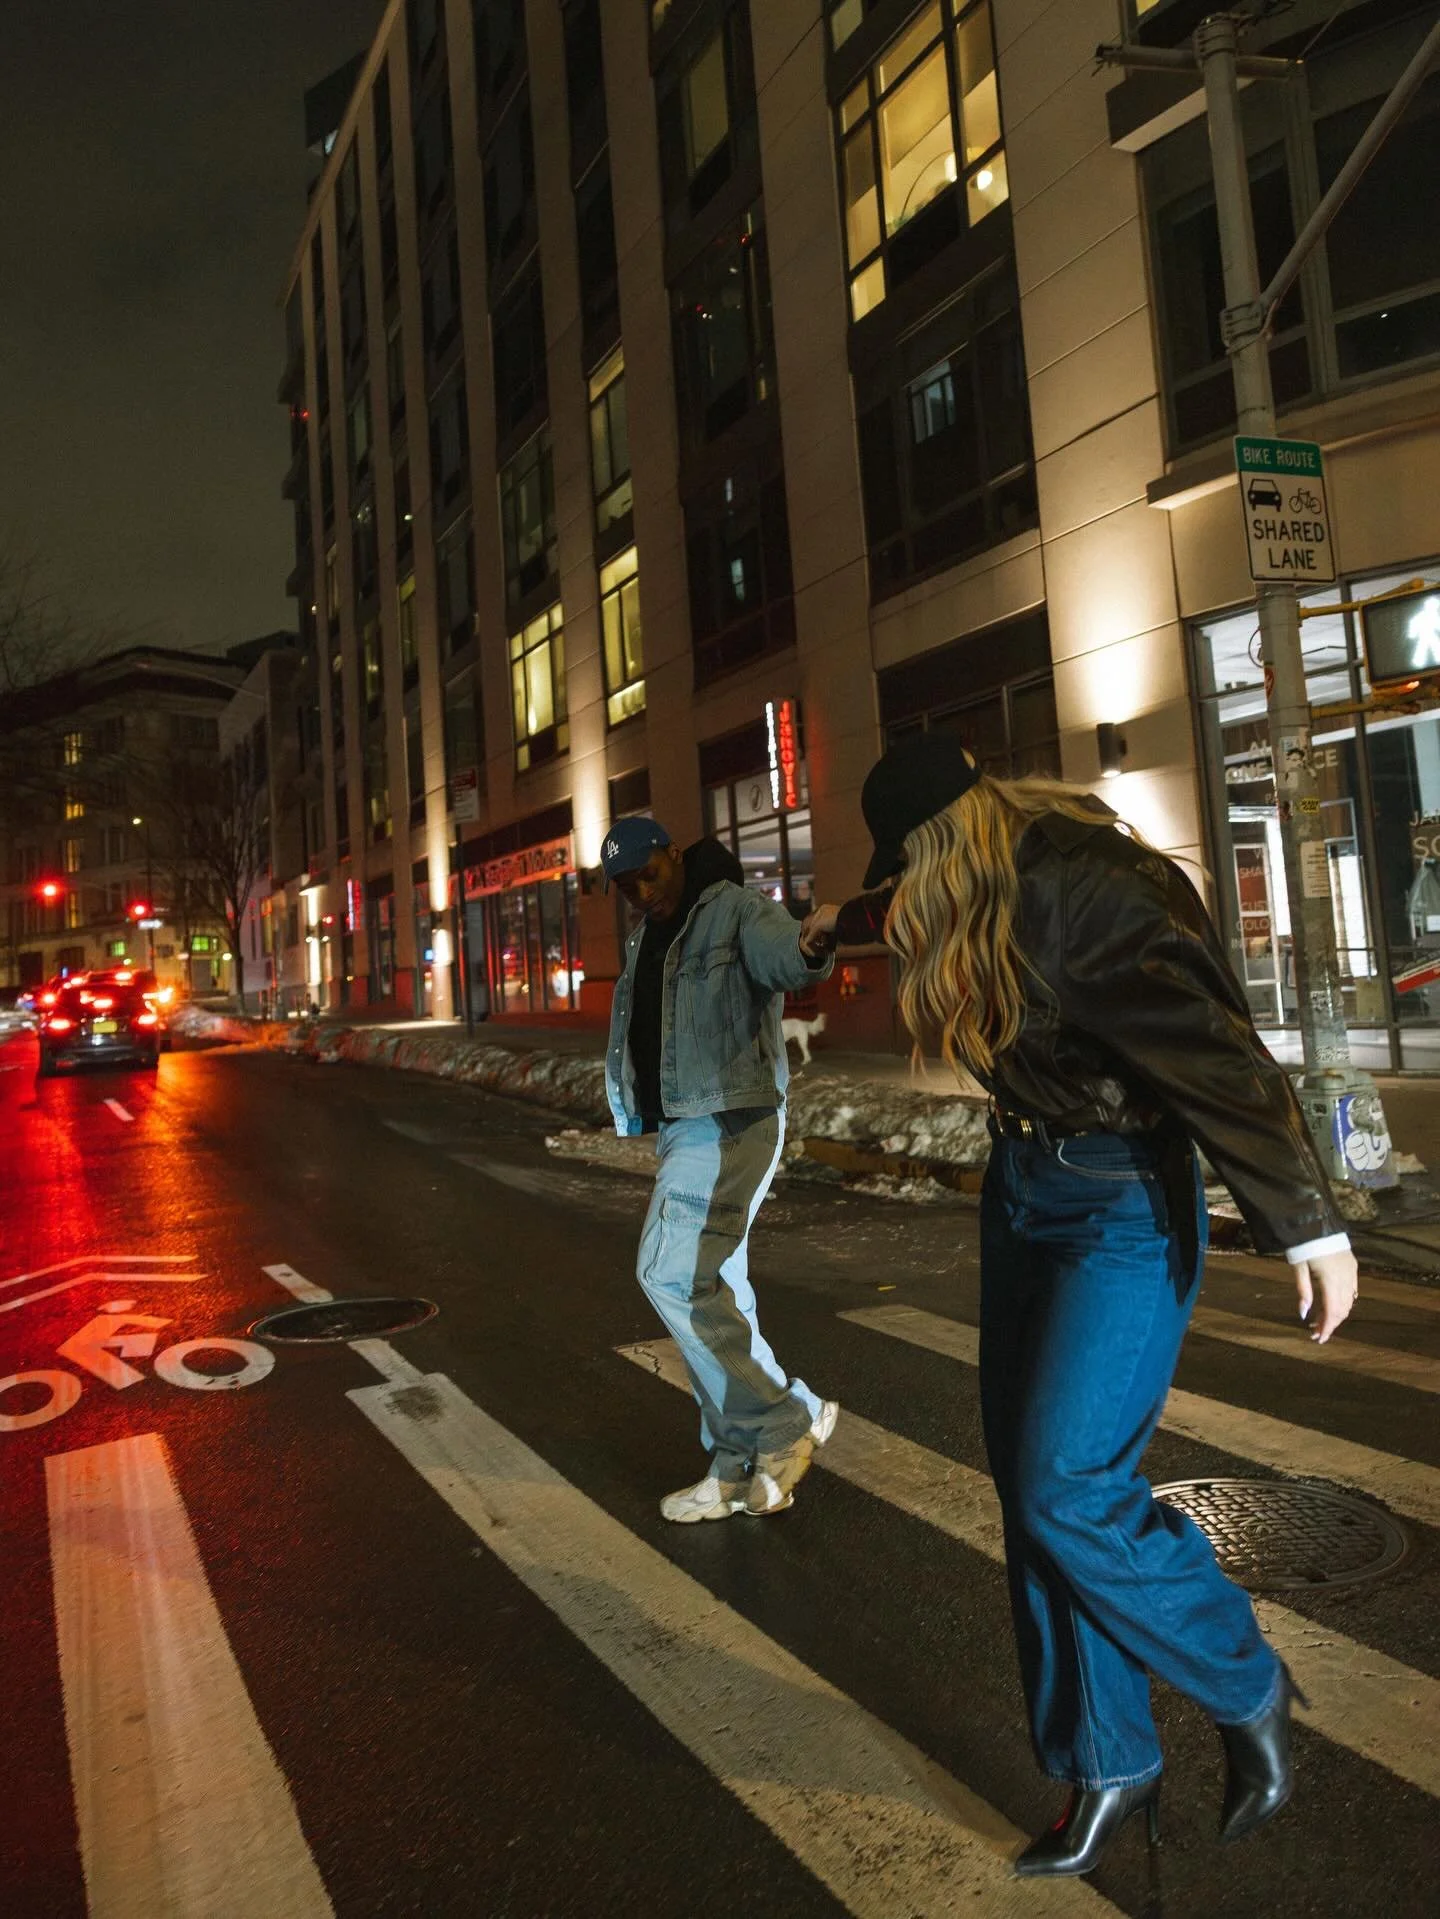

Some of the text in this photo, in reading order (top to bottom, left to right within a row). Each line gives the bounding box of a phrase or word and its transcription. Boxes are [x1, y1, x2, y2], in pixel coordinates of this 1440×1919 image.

[1243, 447, 1315, 468] BIKE ROUTE
[1253, 519, 1325, 542] SHARED
[1268, 548, 1317, 570] LANE
[607, 839, 620, 859] LA
